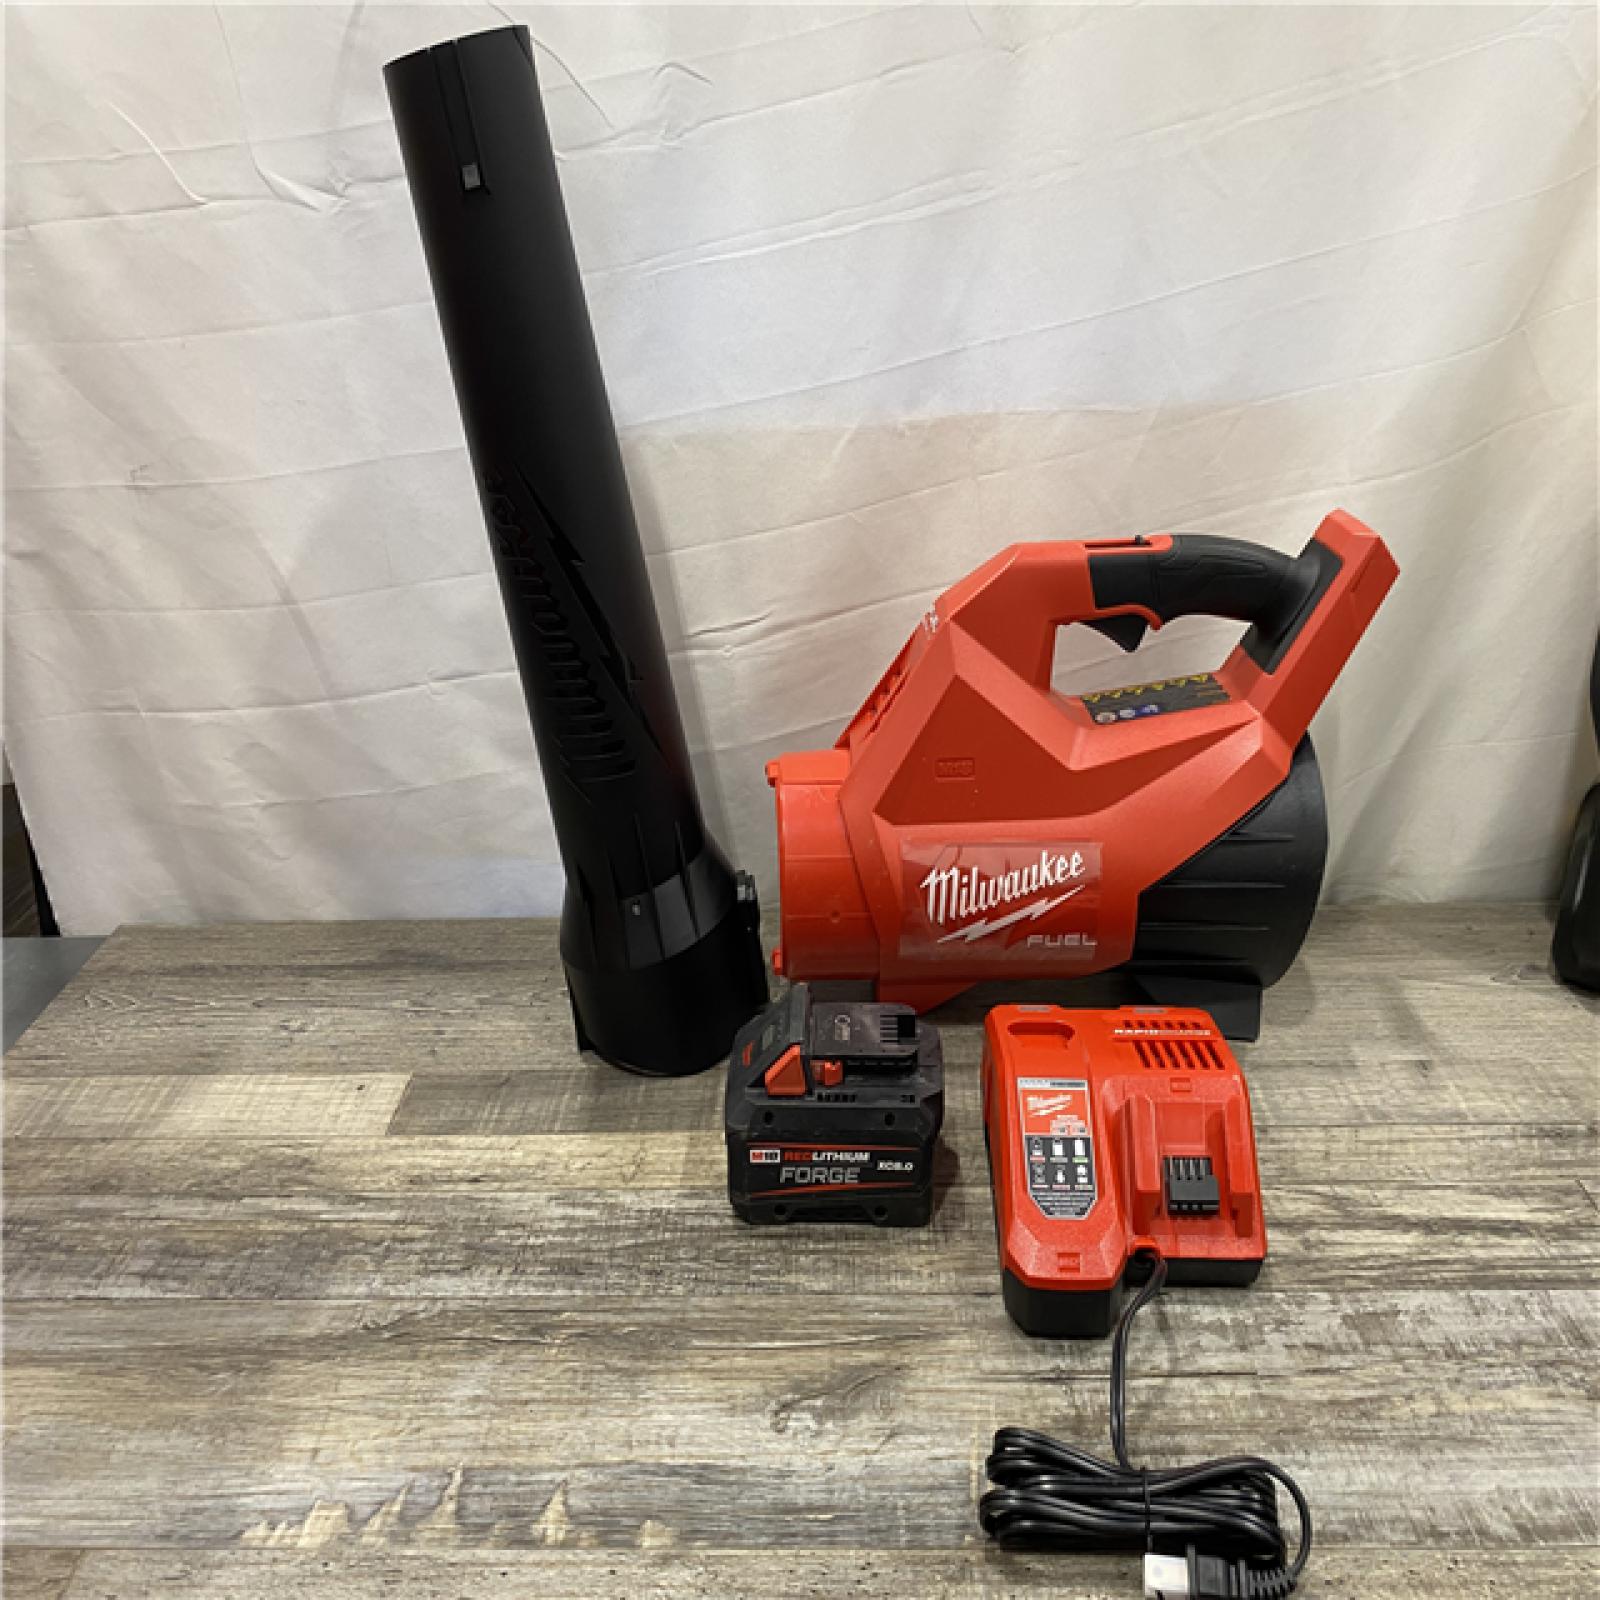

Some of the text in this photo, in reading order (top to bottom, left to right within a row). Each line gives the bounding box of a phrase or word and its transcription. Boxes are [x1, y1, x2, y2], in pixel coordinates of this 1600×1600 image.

[919, 849, 1087, 926] Milwaukee
[1026, 933, 1098, 949] FUEL
[780, 1167, 861, 1183] FORGE
